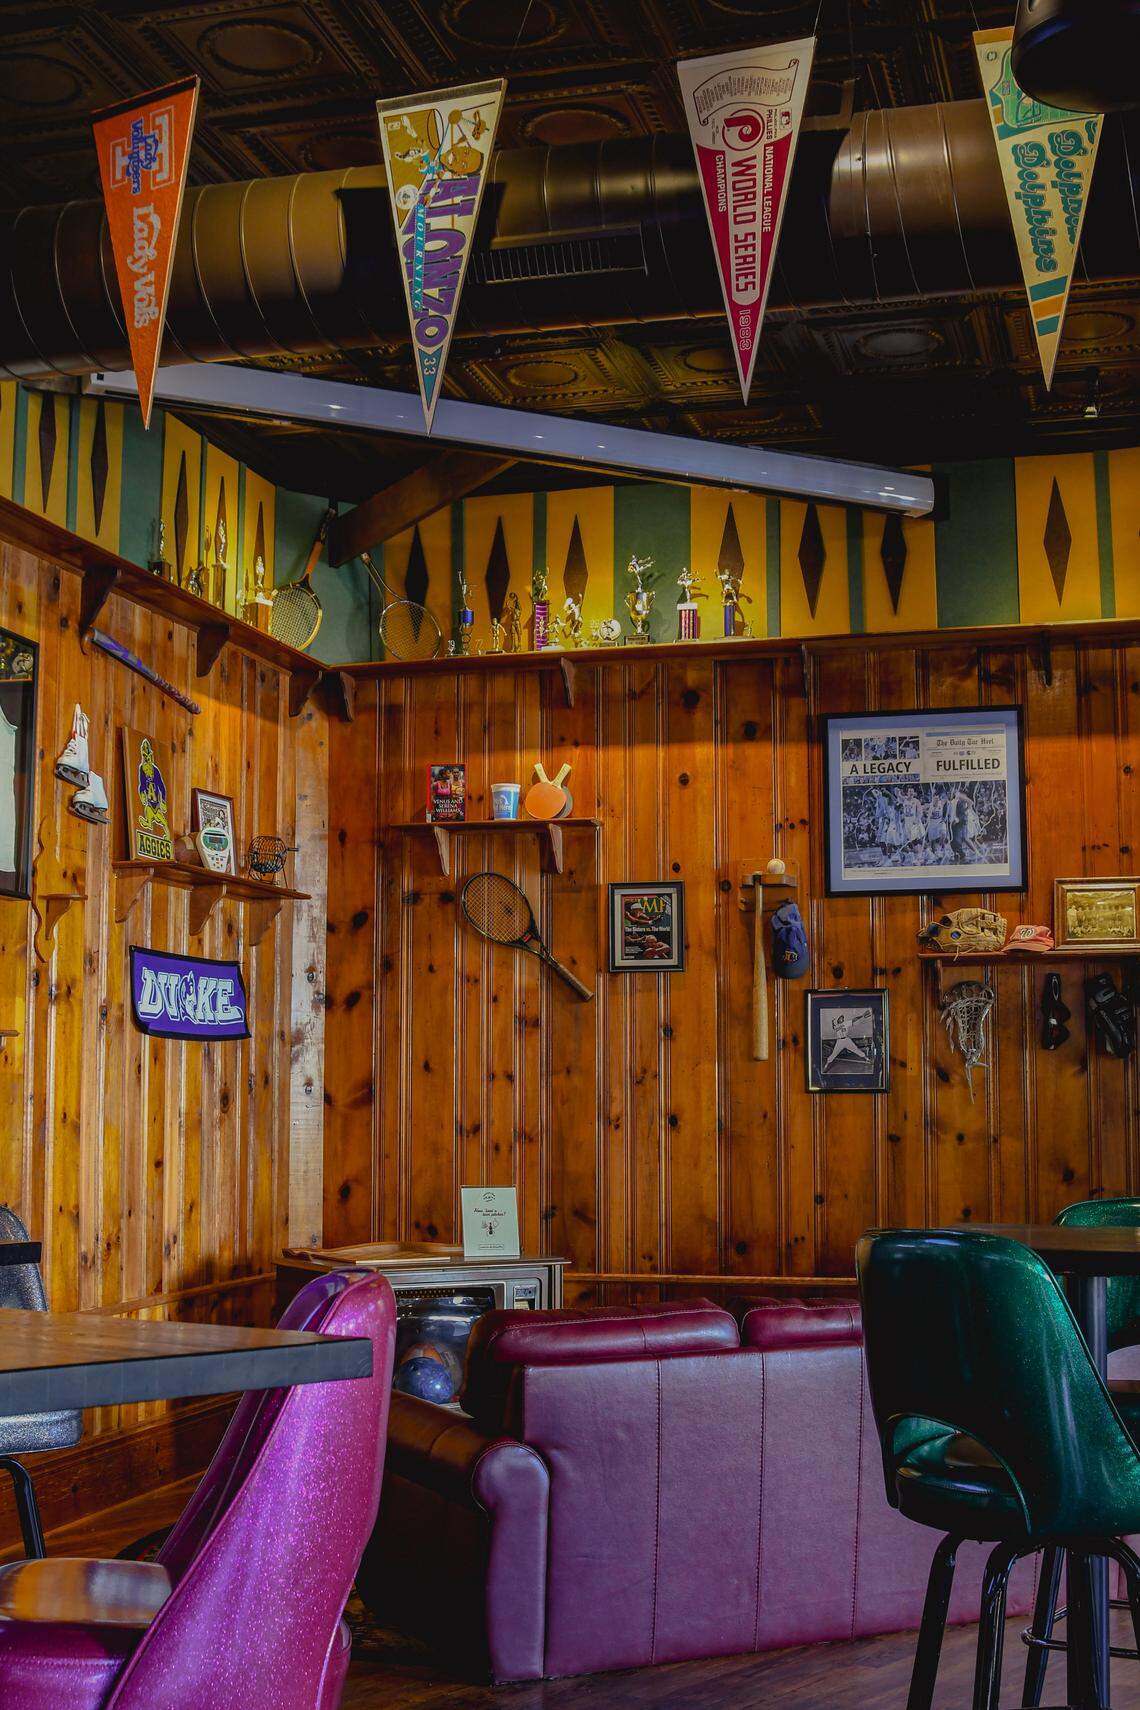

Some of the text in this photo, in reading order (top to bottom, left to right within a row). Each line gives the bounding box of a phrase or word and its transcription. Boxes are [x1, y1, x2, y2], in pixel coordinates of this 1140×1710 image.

[143, 133, 158, 170] Lady
[765, 109, 774, 140] PHILLIES
[126, 118, 144, 194] Volunteers
[715, 154, 727, 212] CHAMPIONS
[762, 146, 774, 233] NATIONAL LEAGUE
[1011, 141, 1058, 273] Dolphins
[731, 154, 757, 294] WORLD SERIES
[127, 203, 161, 329] Lady Vols
[402, 175, 480, 347] ALONZO
[413, 205, 426, 311] MOURNING
[739, 309, 752, 351] 1983
[423, 357, 437, 377] 33
[850, 758, 1001, 775] A LEGACY FULFILLED
[936, 737, 994, 747] The Daily Tar Heel
[139, 833, 172, 860] AGGIES
[138, 966, 244, 1025] DUKE
